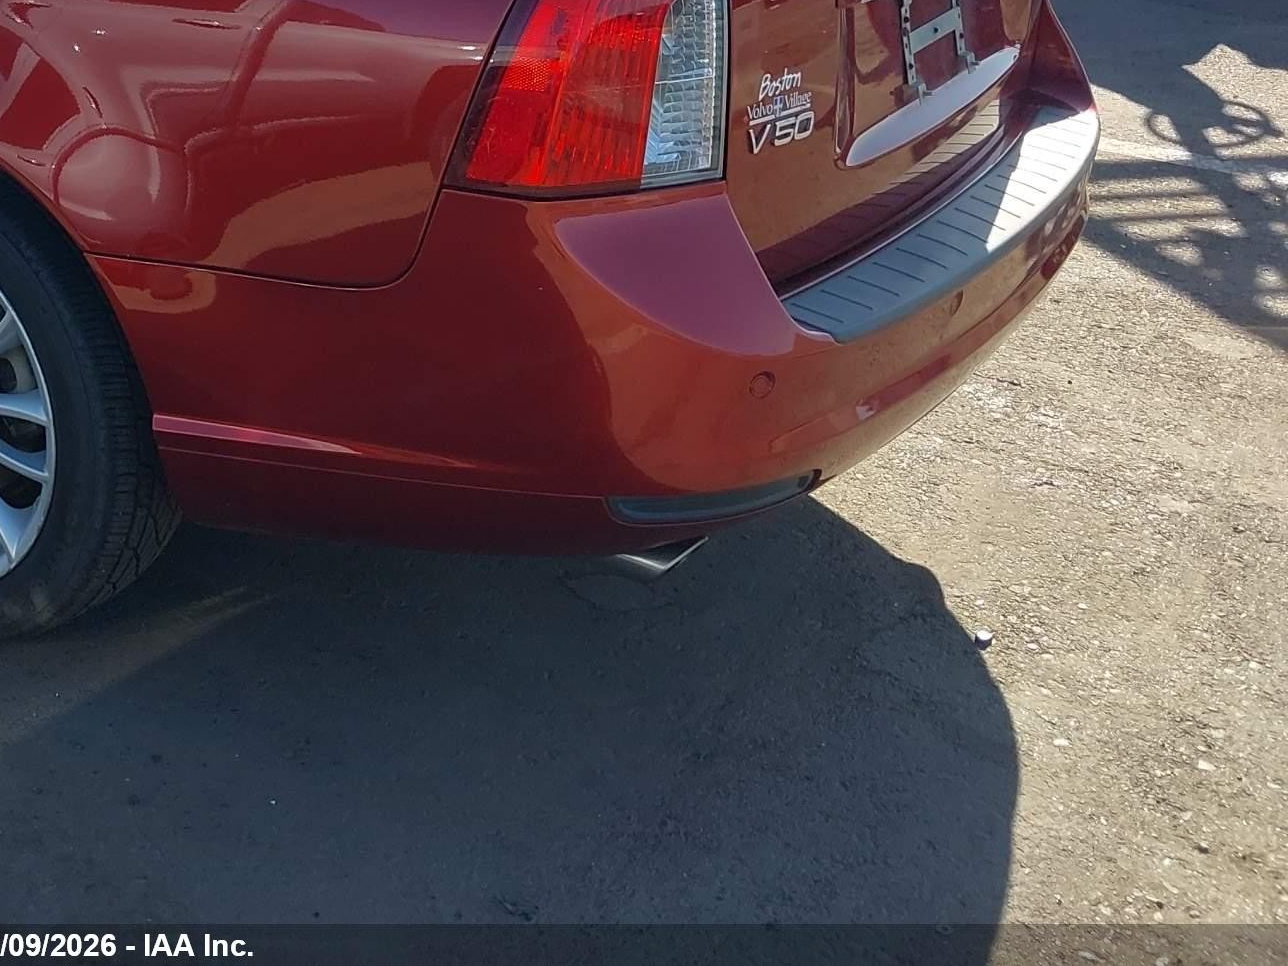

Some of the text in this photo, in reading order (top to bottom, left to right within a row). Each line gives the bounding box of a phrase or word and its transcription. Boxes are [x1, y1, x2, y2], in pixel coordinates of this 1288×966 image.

[758, 67, 802, 102] Boston
[746, 90, 812, 120] Volvo Village
[748, 111, 815, 155] V50
